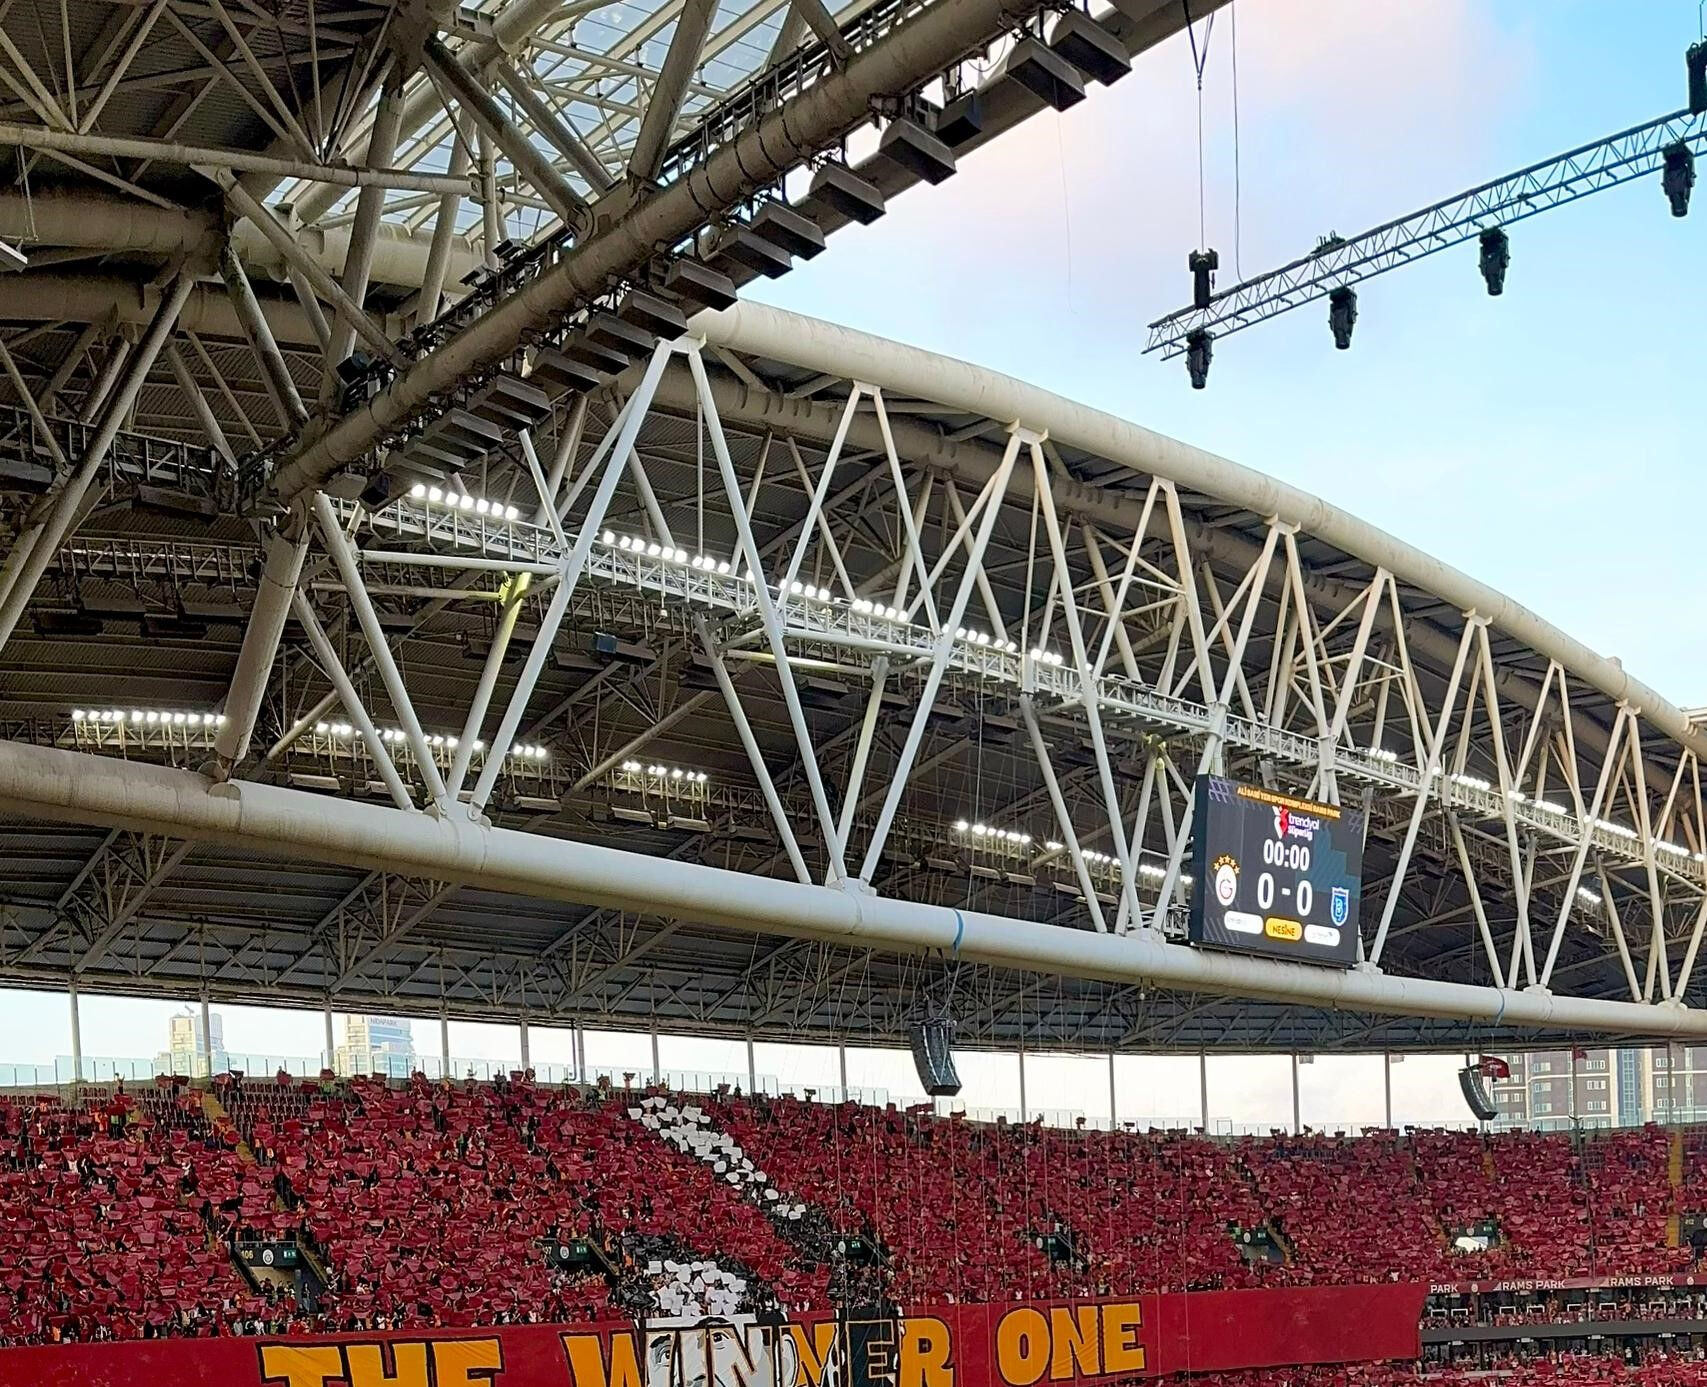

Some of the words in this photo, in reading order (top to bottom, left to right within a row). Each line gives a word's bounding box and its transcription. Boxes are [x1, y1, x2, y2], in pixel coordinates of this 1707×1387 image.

[1288, 813, 1319, 830] trendyol
[1264, 839, 1310, 871] 00:00
[1257, 873, 1274, 909] 0
[1297, 880, 1313, 916] 0
[1430, 1284, 1458, 1293] PARK
[1502, 1281, 1531, 1290] RAMS
[1537, 1280, 1565, 1289] PARK
[1610, 1278, 1639, 1287] RAMS
[1645, 1276, 1674, 1286] PARK
[996, 1300, 1146, 1387] ONE
